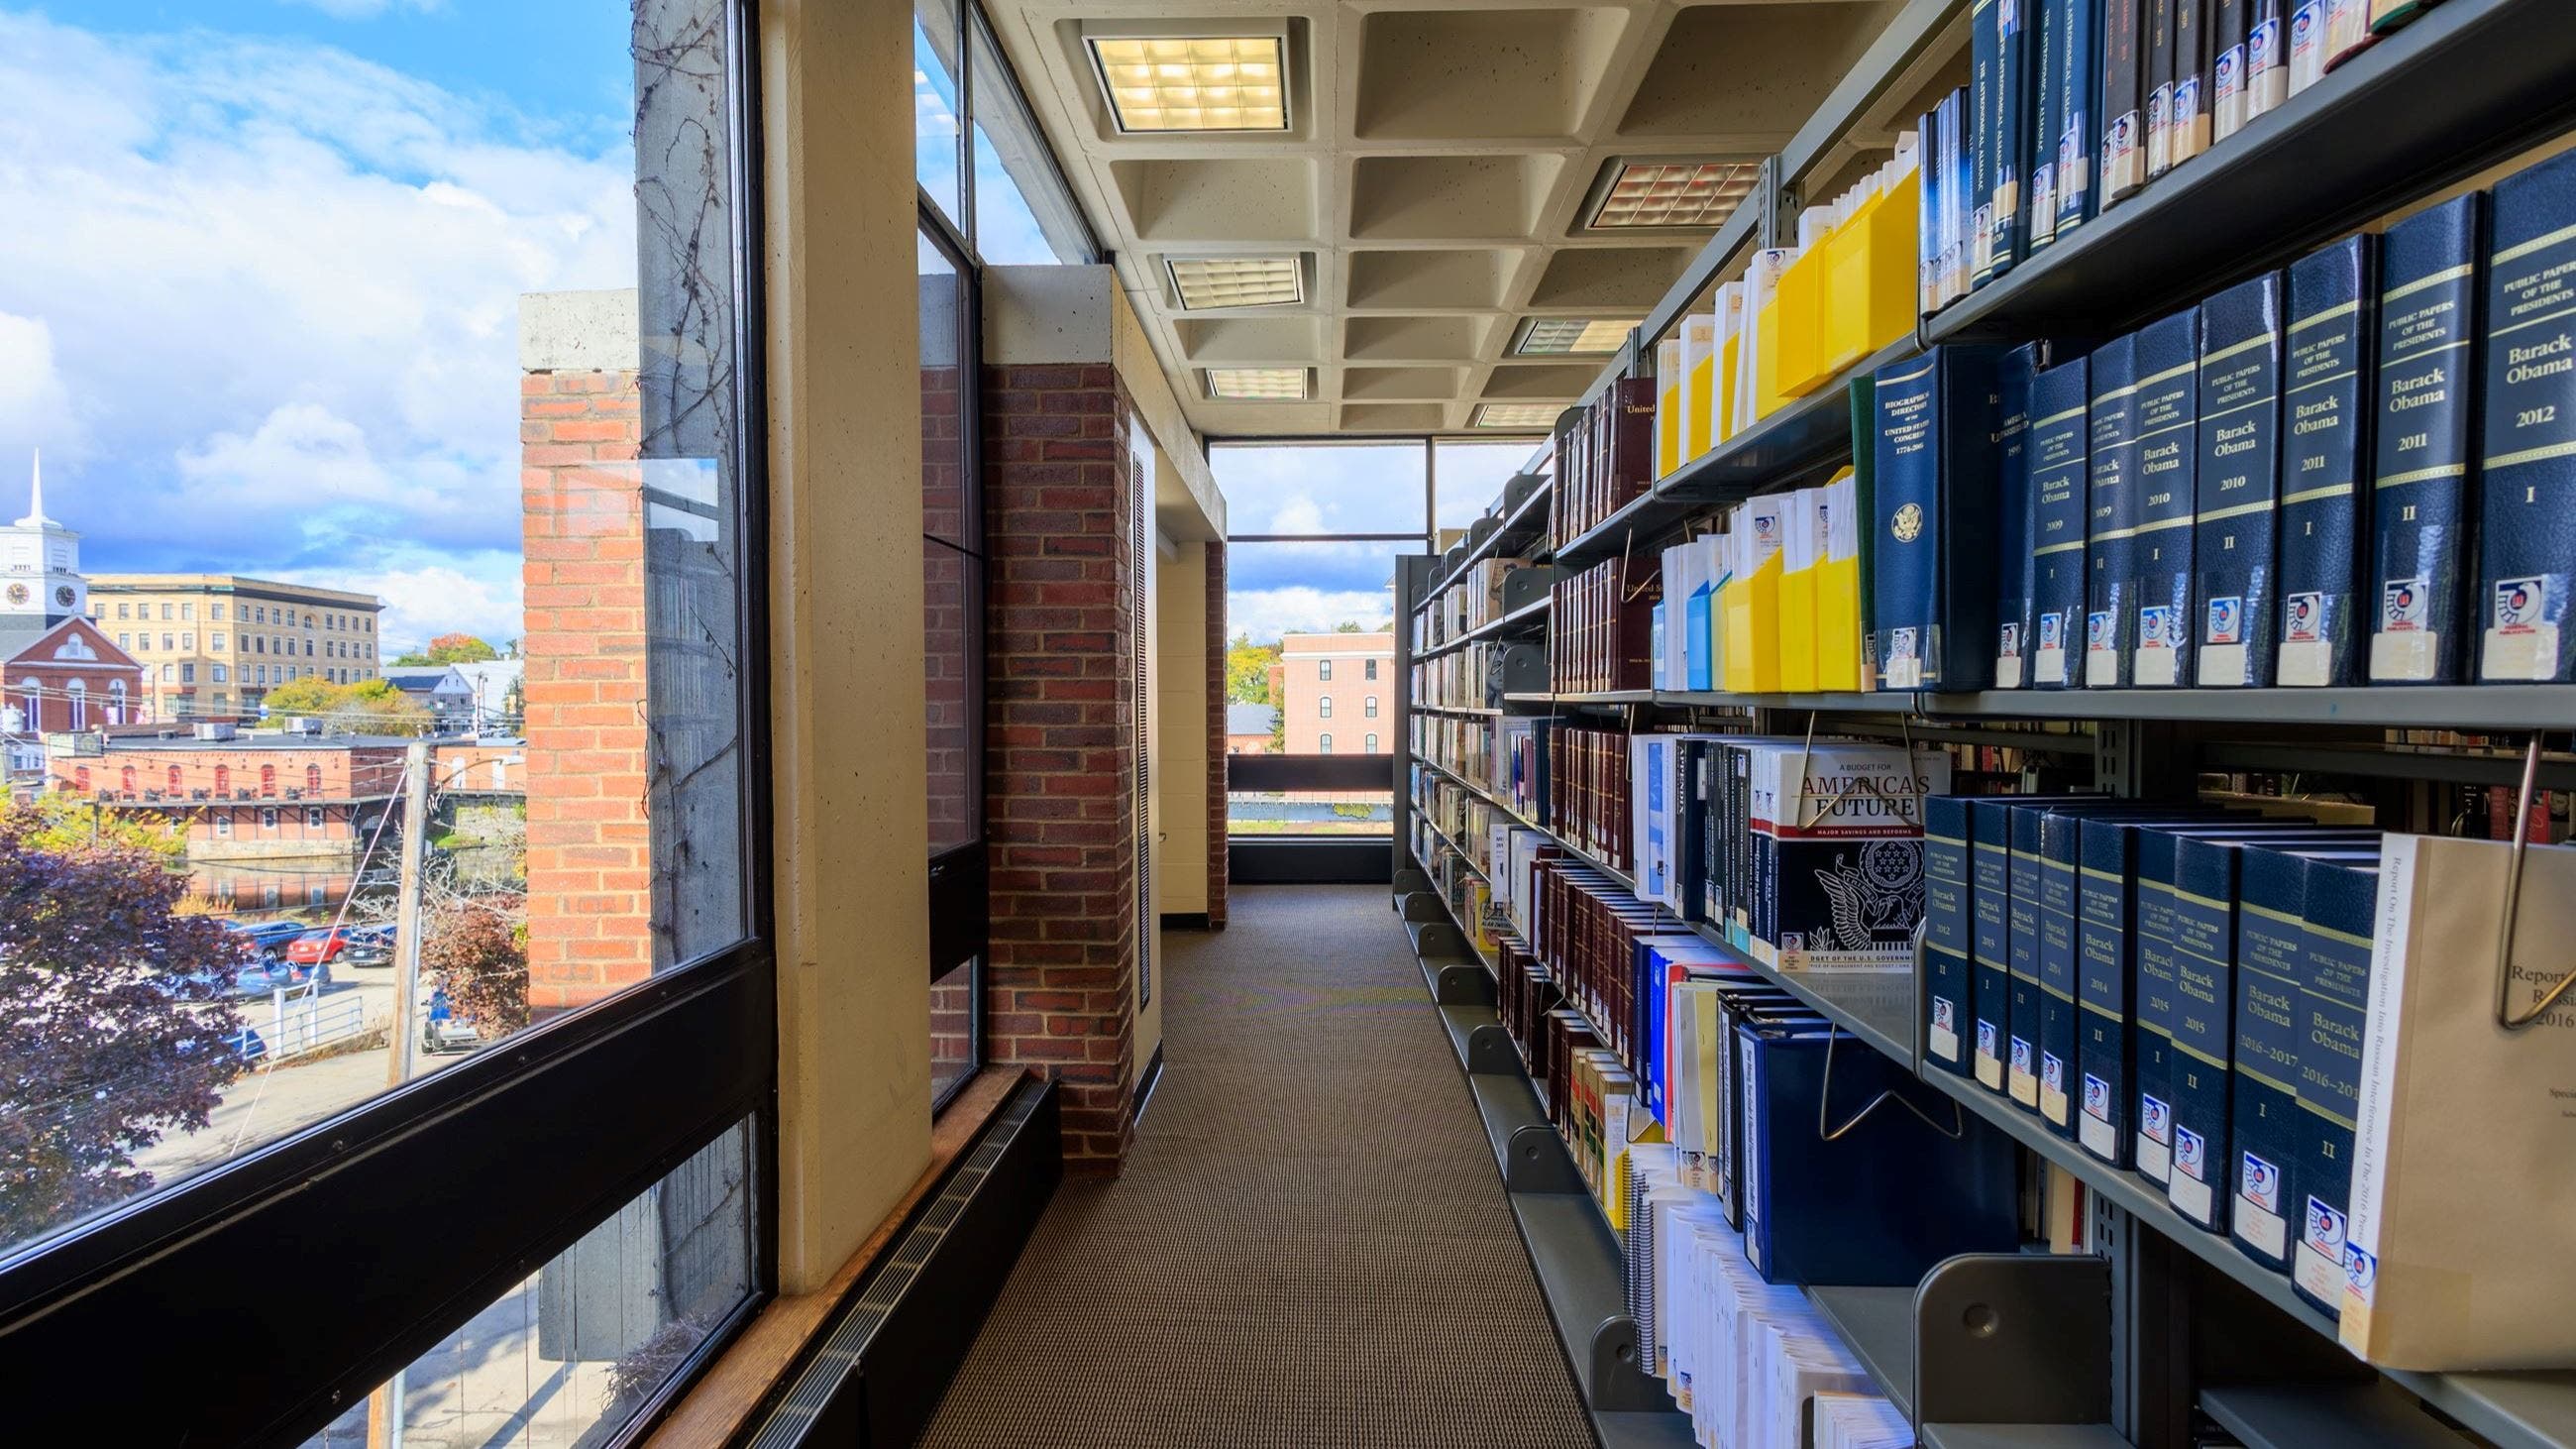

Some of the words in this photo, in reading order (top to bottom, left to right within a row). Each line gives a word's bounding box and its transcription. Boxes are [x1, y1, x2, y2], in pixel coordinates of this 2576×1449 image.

[2065, 7, 2074, 82] ASTRONOMICAL
[2039, 31, 2049, 105] ASTRONOMICAL
[2504, 273, 2540, 293] PUBLIC
[2542, 261, 2576, 280] PAPER
[2522, 287, 2538, 299] OF
[2540, 279, 2562, 294] THE
[2511, 288, 2575, 316] PRESIDENTS
[2388, 312, 2418, 330] PUBLIC
[2418, 300, 2456, 318] PAPERS
[2402, 324, 2415, 337] OF
[2416, 317, 2435, 332] THE
[2292, 344, 2317, 359] PUBLIC
[2317, 333, 2347, 349] PAPERS
[2393, 327, 2447, 351] PRESIDENTS
[2304, 355, 2315, 366] OF
[2316, 349, 2331, 362] THE
[2509, 333, 2573, 366] Barack
[2211, 373, 2235, 388] PUBLIC
[2235, 364, 2261, 378] PAPERS
[2297, 358, 2340, 379] PRESIDENTS
[2506, 356, 2574, 385] Obama
[2223, 383, 2234, 392] OF
[2234, 378, 2248, 390] THE
[2391, 367, 2446, 395] Barack
[2140, 396, 2161, 410] PUBLIC
[2161, 390, 2185, 403] PAPERS
[2216, 387, 2256, 404] PRESIDENTS
[2389, 389, 2446, 413] Obama
[1627, 403, 1656, 414] United
[2149, 406, 2159, 416] OF
[2160, 402, 2173, 413] THE
[2296, 394, 2339, 419] Barack
[2144, 410, 2180, 427] PRESIDENTS
[2294, 413, 2339, 436] Obama
[2516, 405, 2556, 428] 2012
[1884, 425, 1912, 437] UNITED
[2215, 420, 2256, 442] Barack
[2144, 441, 2180, 462] Barack
[2214, 437, 2256, 458] Obama
[2398, 432, 2428, 452] 2011
[2093, 458, 2119, 476] arack
[2142, 457, 2180, 476] Obama
[2301, 455, 2326, 472] 2011
[2042, 476, 2070, 492] Barack
[2093, 475, 2120, 489] bama
[2219, 475, 2246, 492] 2010
[2041, 491, 2071, 504] Obama
[2148, 492, 2171, 506] 2010
[2525, 486, 2535, 503] I
[2402, 504, 2416, 522] II
[2045, 519, 2064, 532] 2009
[2305, 521, 2311, 536] I
[2223, 535, 2235, 551] II
[2096, 557, 2104, 570] II
[2153, 547, 2159, 561] I
[1815, 798, 1914, 817] FUTURE
[2390, 856, 2402, 894] Report
[1933, 888, 1956, 902] Barack
[2387, 894, 2399, 914] On
[1933, 898, 1956, 913] Obama
[1979, 898, 1999, 913] Barack
[1978, 910, 2000, 925] Obama
[2012, 909, 2034, 925] Barack
[2178, 914, 2196, 927] PUBLIC
[2197, 921, 2219, 935] PAPERS
[1936, 924, 1951, 937] 2012
[2011, 920, 2035, 936] Obama
[2045, 920, 2068, 937] Barack
[2386, 917, 2396, 937] The
[2045, 934, 2068, 950] Obama
[2085, 933, 2115, 952] Barack
[2181, 934, 2214, 951] PRESIDENTS
[2246, 930, 2270, 944] PUBLIC
[2270, 937, 2298, 952] PAPERS
[2085, 947, 2115, 966] Obama
[2250, 952, 2292, 971] PRESIDENTS
[2267, 947, 2284, 958] THE
[1939, 963, 1946, 975] II
[2143, 962, 2174, 982] Obam
[2309, 951, 2335, 968] PUBLIC
[2337, 960, 2367, 977] PAPERS
[2180, 965, 2214, 989] Barack
[2335, 971, 2352, 984] THE
[2379, 939, 2394, 1011] Investigation
[2091, 978, 2108, 994] 2014
[2180, 980, 2215, 1004] Obama
[2314, 976, 2362, 998] PRESIDENTS
[2150, 996, 2170, 1012] 2015
[2248, 984, 2291, 1012] Barack
[2247, 1000, 2291, 1028] Obama
[2377, 1011, 2387, 1034] Into
[2185, 1016, 2205, 1035] 2015
[2312, 1011, 2360, 1042] Barack
[2093, 1029, 2103, 1043] II
[2311, 1029, 2360, 1059] Obama
[2155, 1051, 2161, 1063] I
[2372, 1034, 2385, 1078] Russian
[2188, 1073, 2198, 1090] II
[2302, 1065, 2360, 1101] 2016-201
[2259, 1102, 2267, 1118] I
[2367, 1078, 2381, 1144] Interference
[2321, 1140, 2335, 1160] II
[2364, 1141, 2375, 1159] In
[2362, 1158, 2373, 1181] The
[2359, 1182, 2371, 1213] 2016
